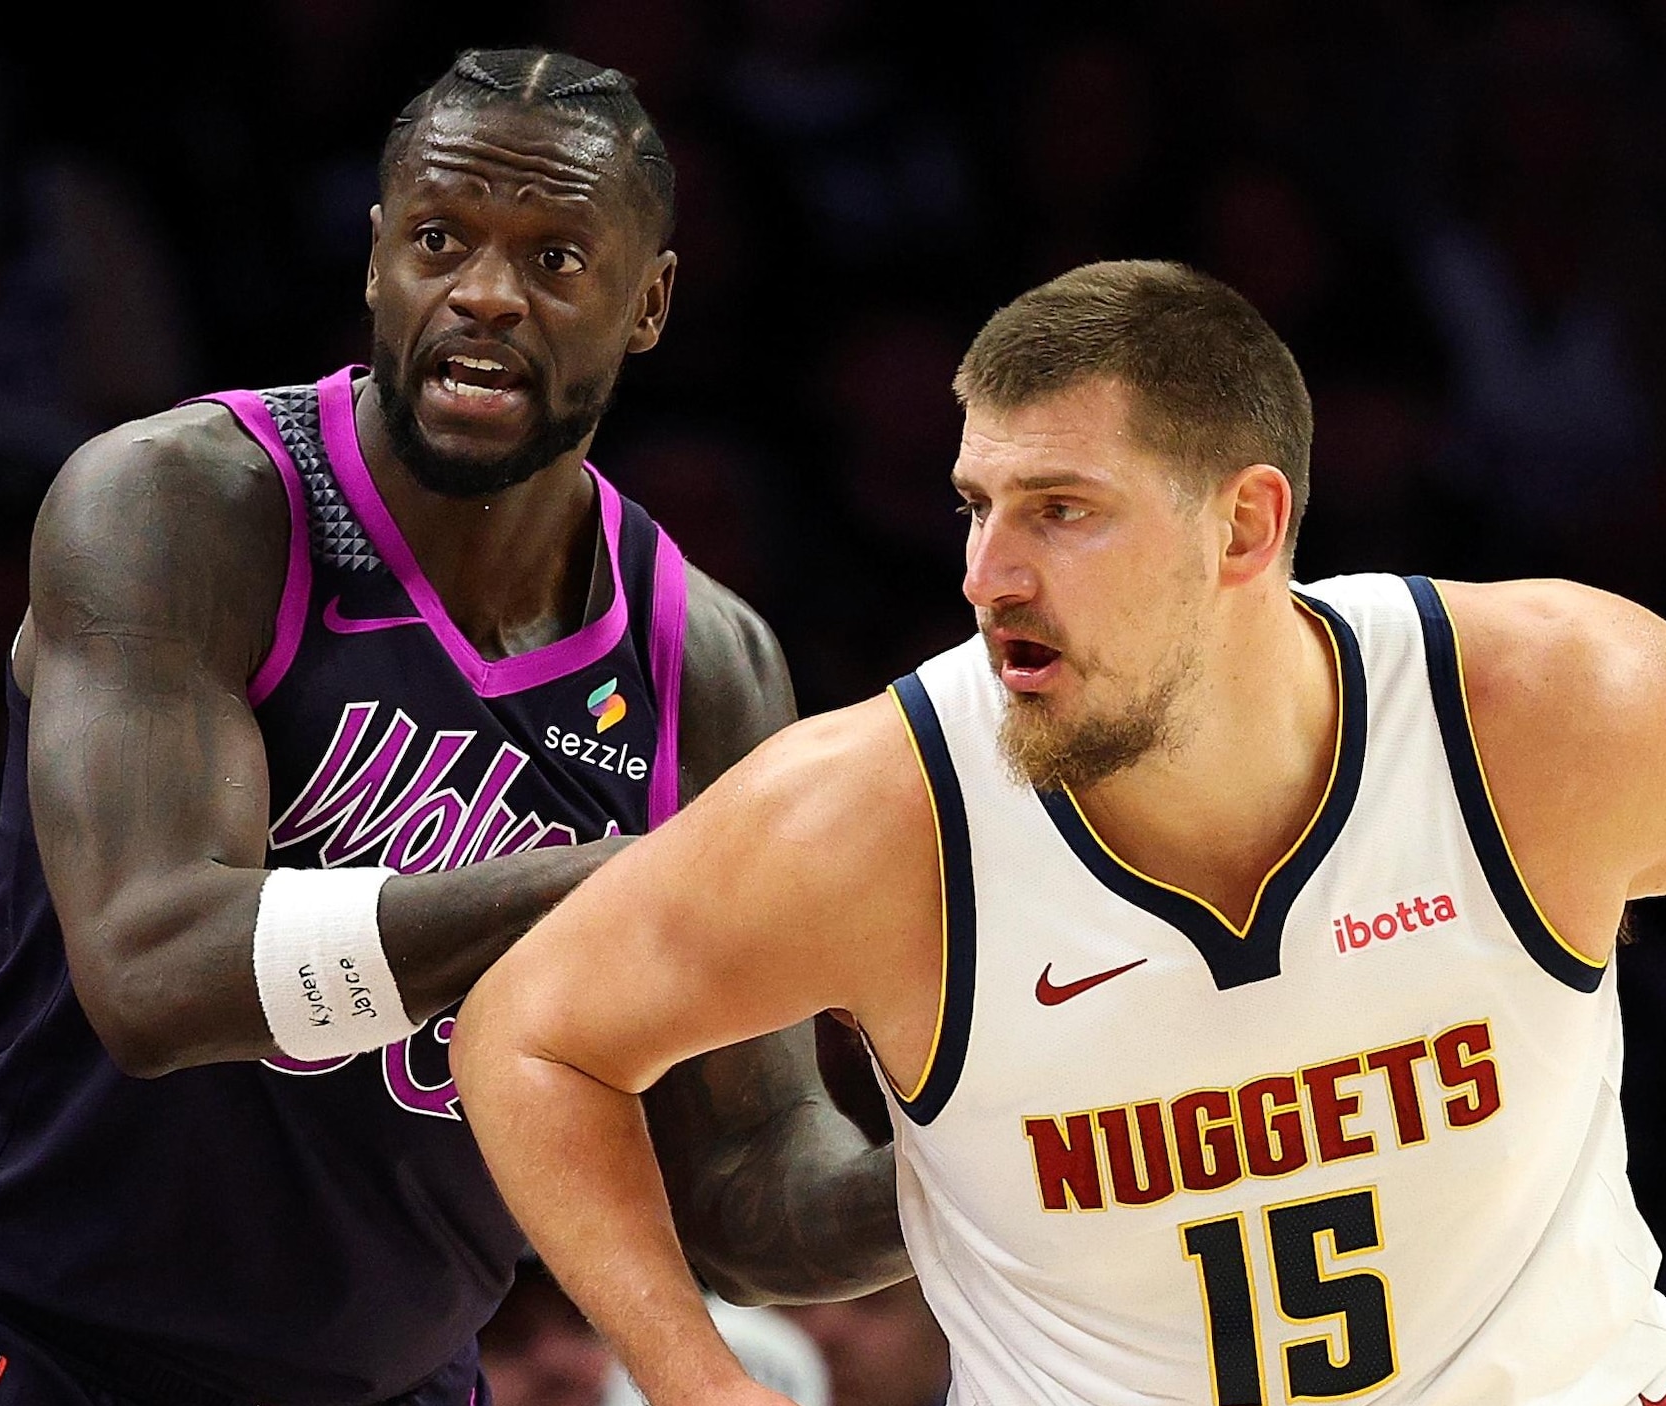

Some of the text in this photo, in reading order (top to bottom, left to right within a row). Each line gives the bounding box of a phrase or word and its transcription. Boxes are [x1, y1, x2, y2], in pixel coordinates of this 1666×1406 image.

[544, 723, 648, 780] sezzle
[268, 700, 622, 876] Wolv
[1334, 893, 1458, 955] ibotta
[298, 963, 334, 1028] Kyden
[339, 957, 377, 1018] Jayce
[1021, 1016, 1504, 1214] NUGGETS
